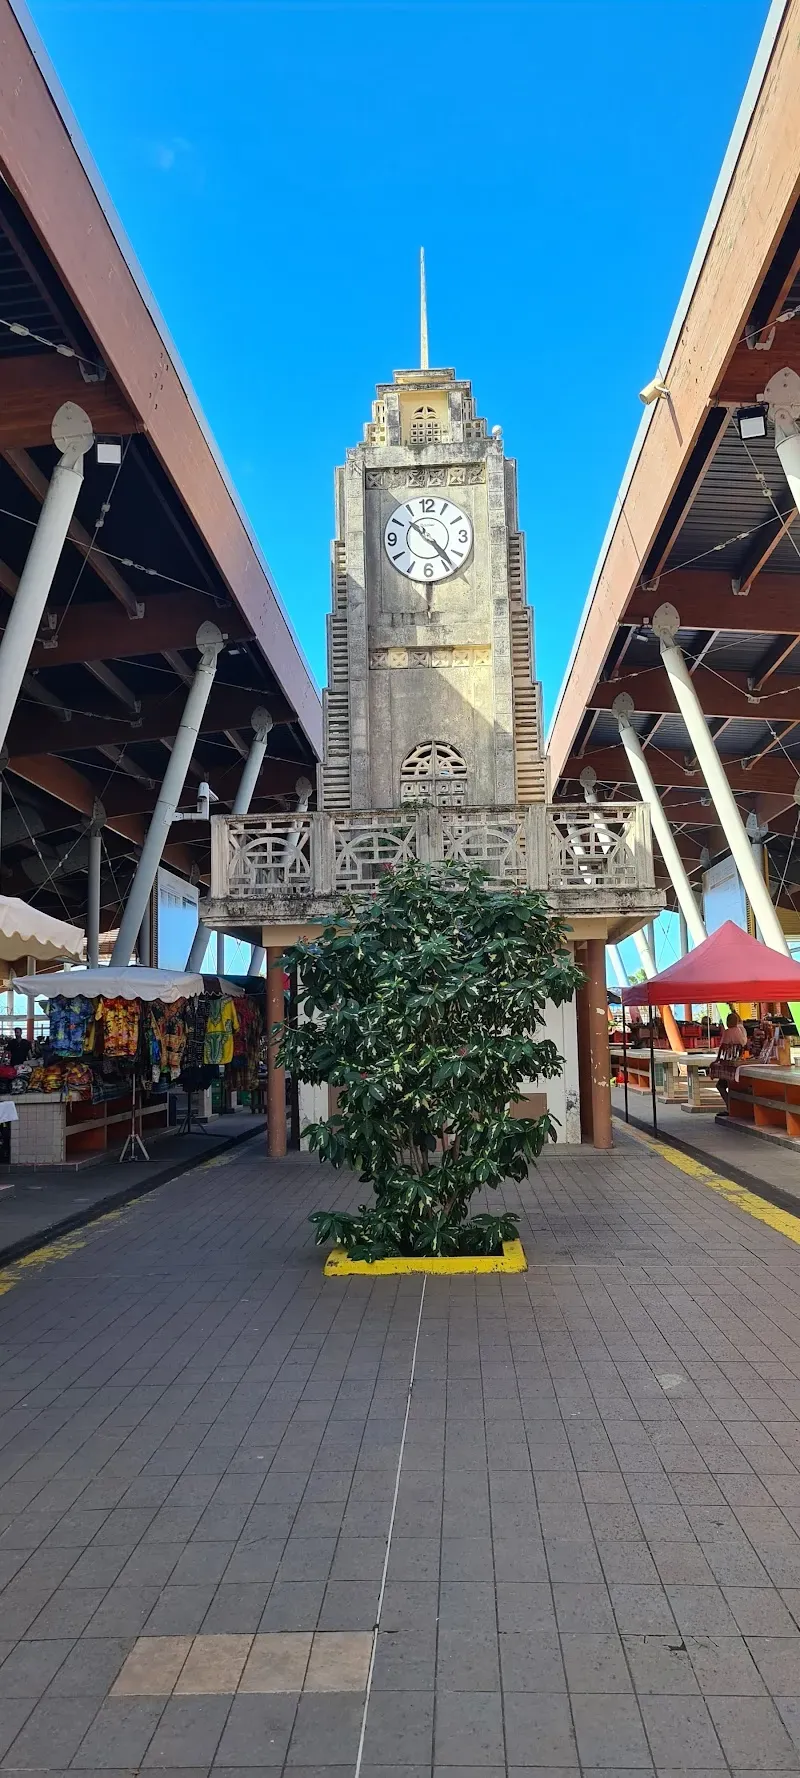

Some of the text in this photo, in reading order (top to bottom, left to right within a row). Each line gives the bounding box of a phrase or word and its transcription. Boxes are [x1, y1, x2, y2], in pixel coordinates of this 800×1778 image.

[419, 499, 435, 513] 12
[387, 532, 398, 547] 9
[458, 529, 468, 543] 3
[423, 563, 434, 578] 6
